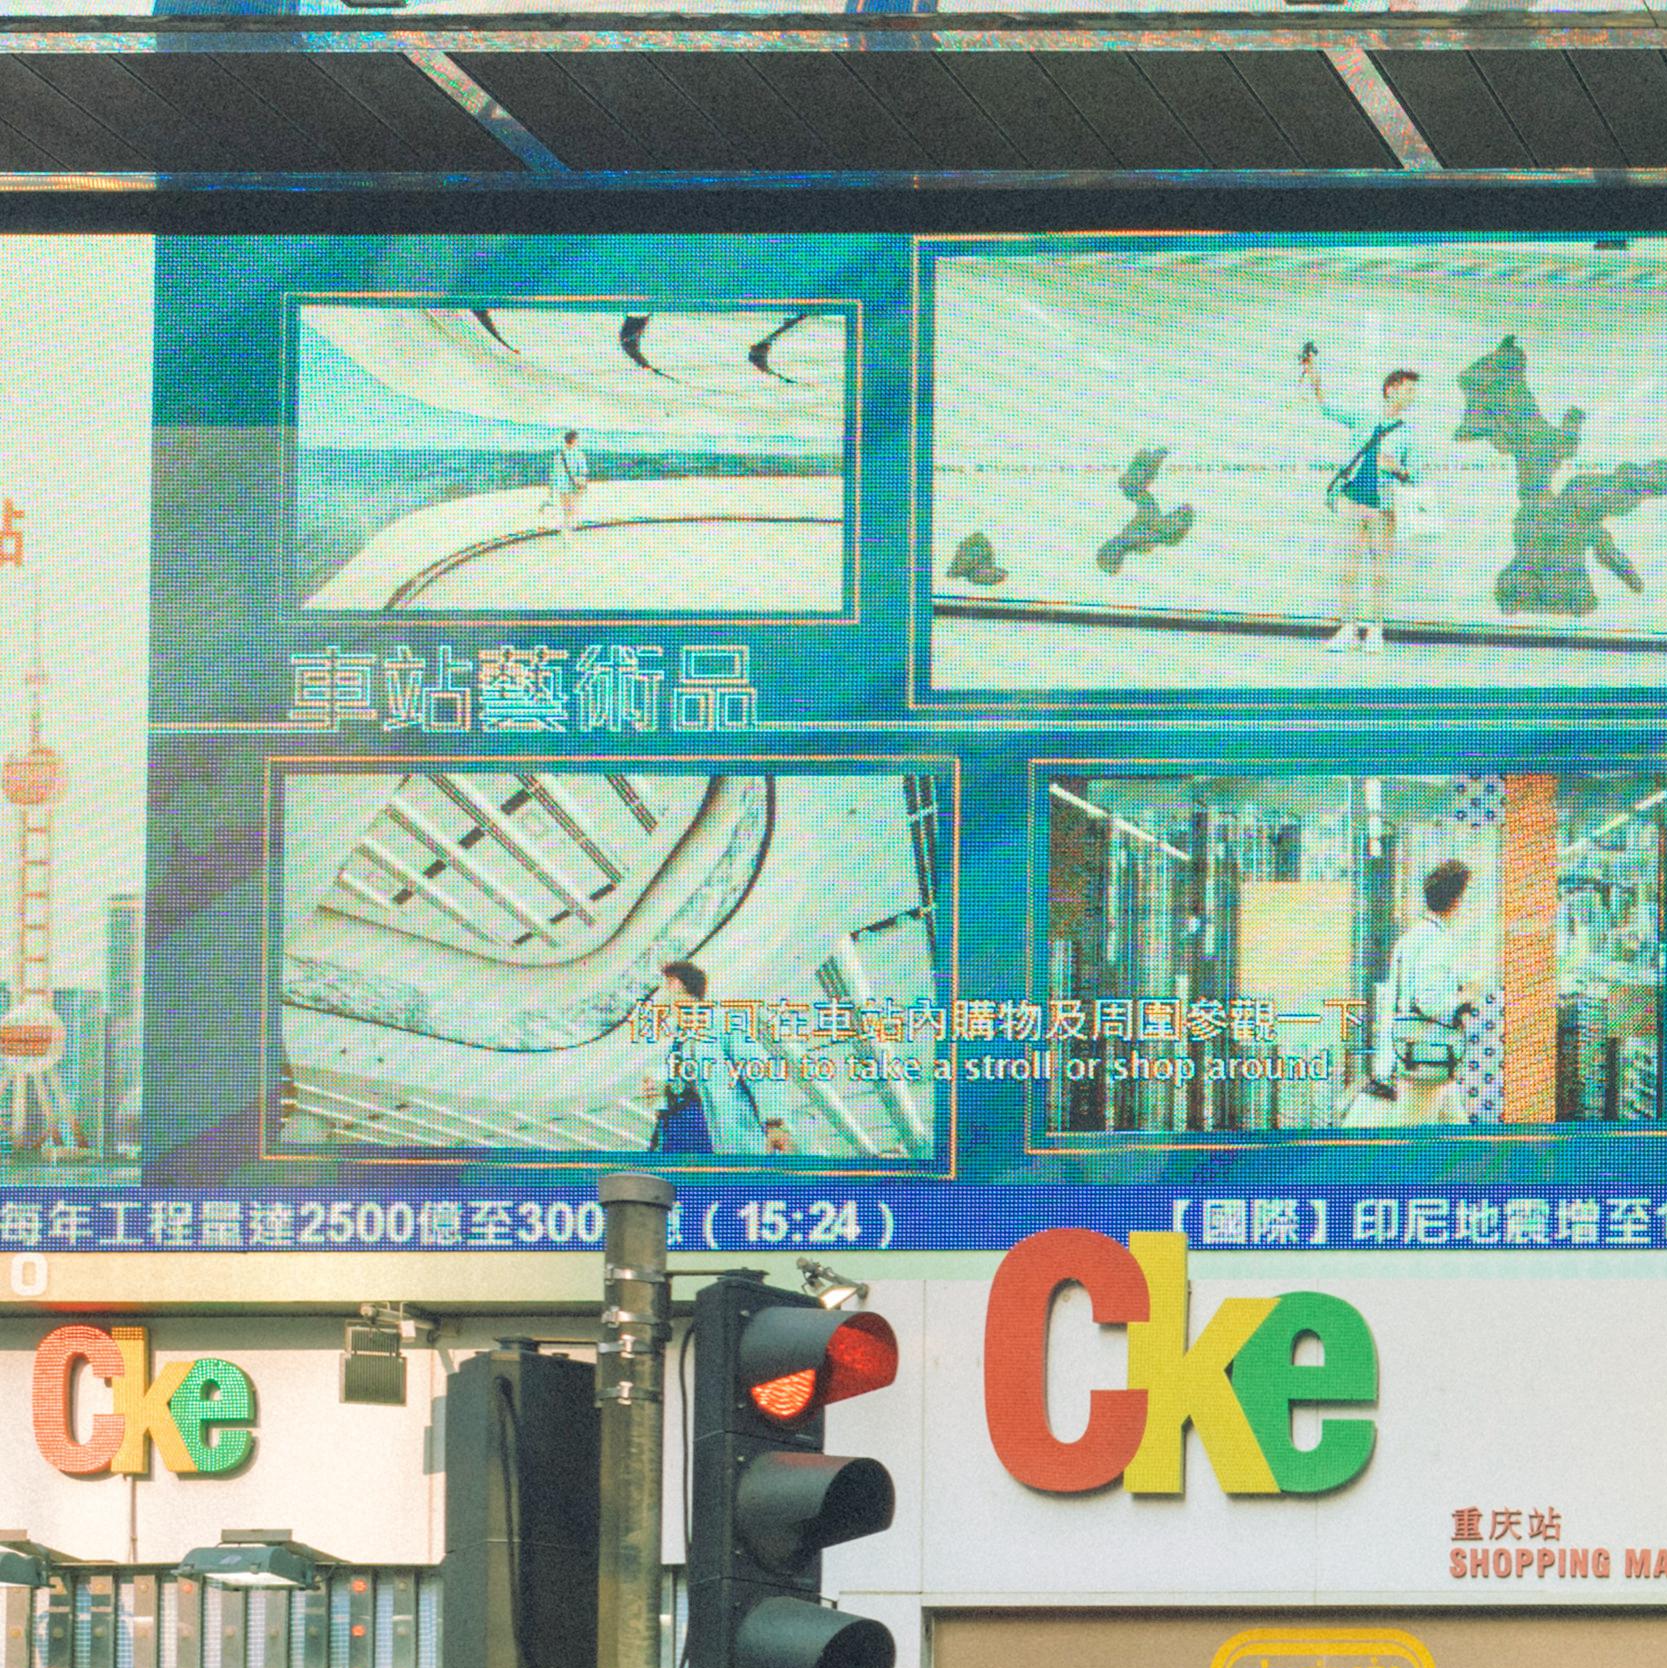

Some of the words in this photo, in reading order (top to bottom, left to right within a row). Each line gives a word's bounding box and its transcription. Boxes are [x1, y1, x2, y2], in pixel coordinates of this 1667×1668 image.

[289, 646, 758, 731] 車站藝術品
[667, 1052, 715, 1081] for
[729, 1055, 789, 1088] you
[800, 1053, 836, 1081] to
[849, 1051, 921, 1081] take
[934, 1056, 957, 1081] a
[964, 1050, 1054, 1081] stroll
[1065, 1056, 1100, 1081] or
[1113, 1050, 1195, 1087] shop
[1206, 1050, 1330, 1081] around
[1451, 1506, 1562, 1542] 重庆站
[1449, 1547, 1611, 1579] SHOPPING
